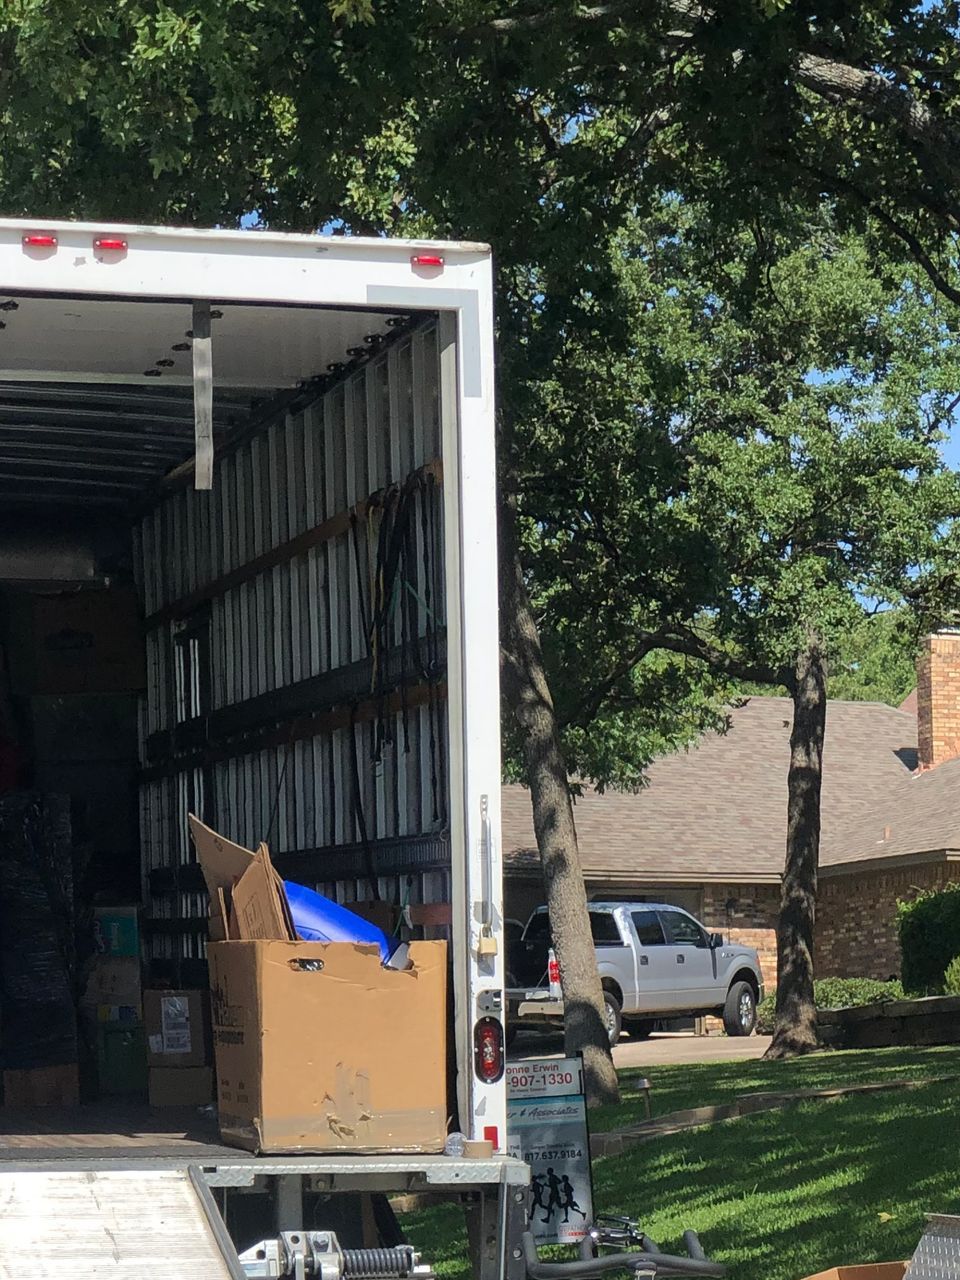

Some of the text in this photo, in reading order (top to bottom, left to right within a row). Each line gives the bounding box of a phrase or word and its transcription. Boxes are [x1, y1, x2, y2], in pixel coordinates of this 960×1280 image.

[506, 1063, 559, 1075] onne Erwin
[507, 1072, 573, 1088] -907-1330
[528, 1106, 580, 1117] Associates
